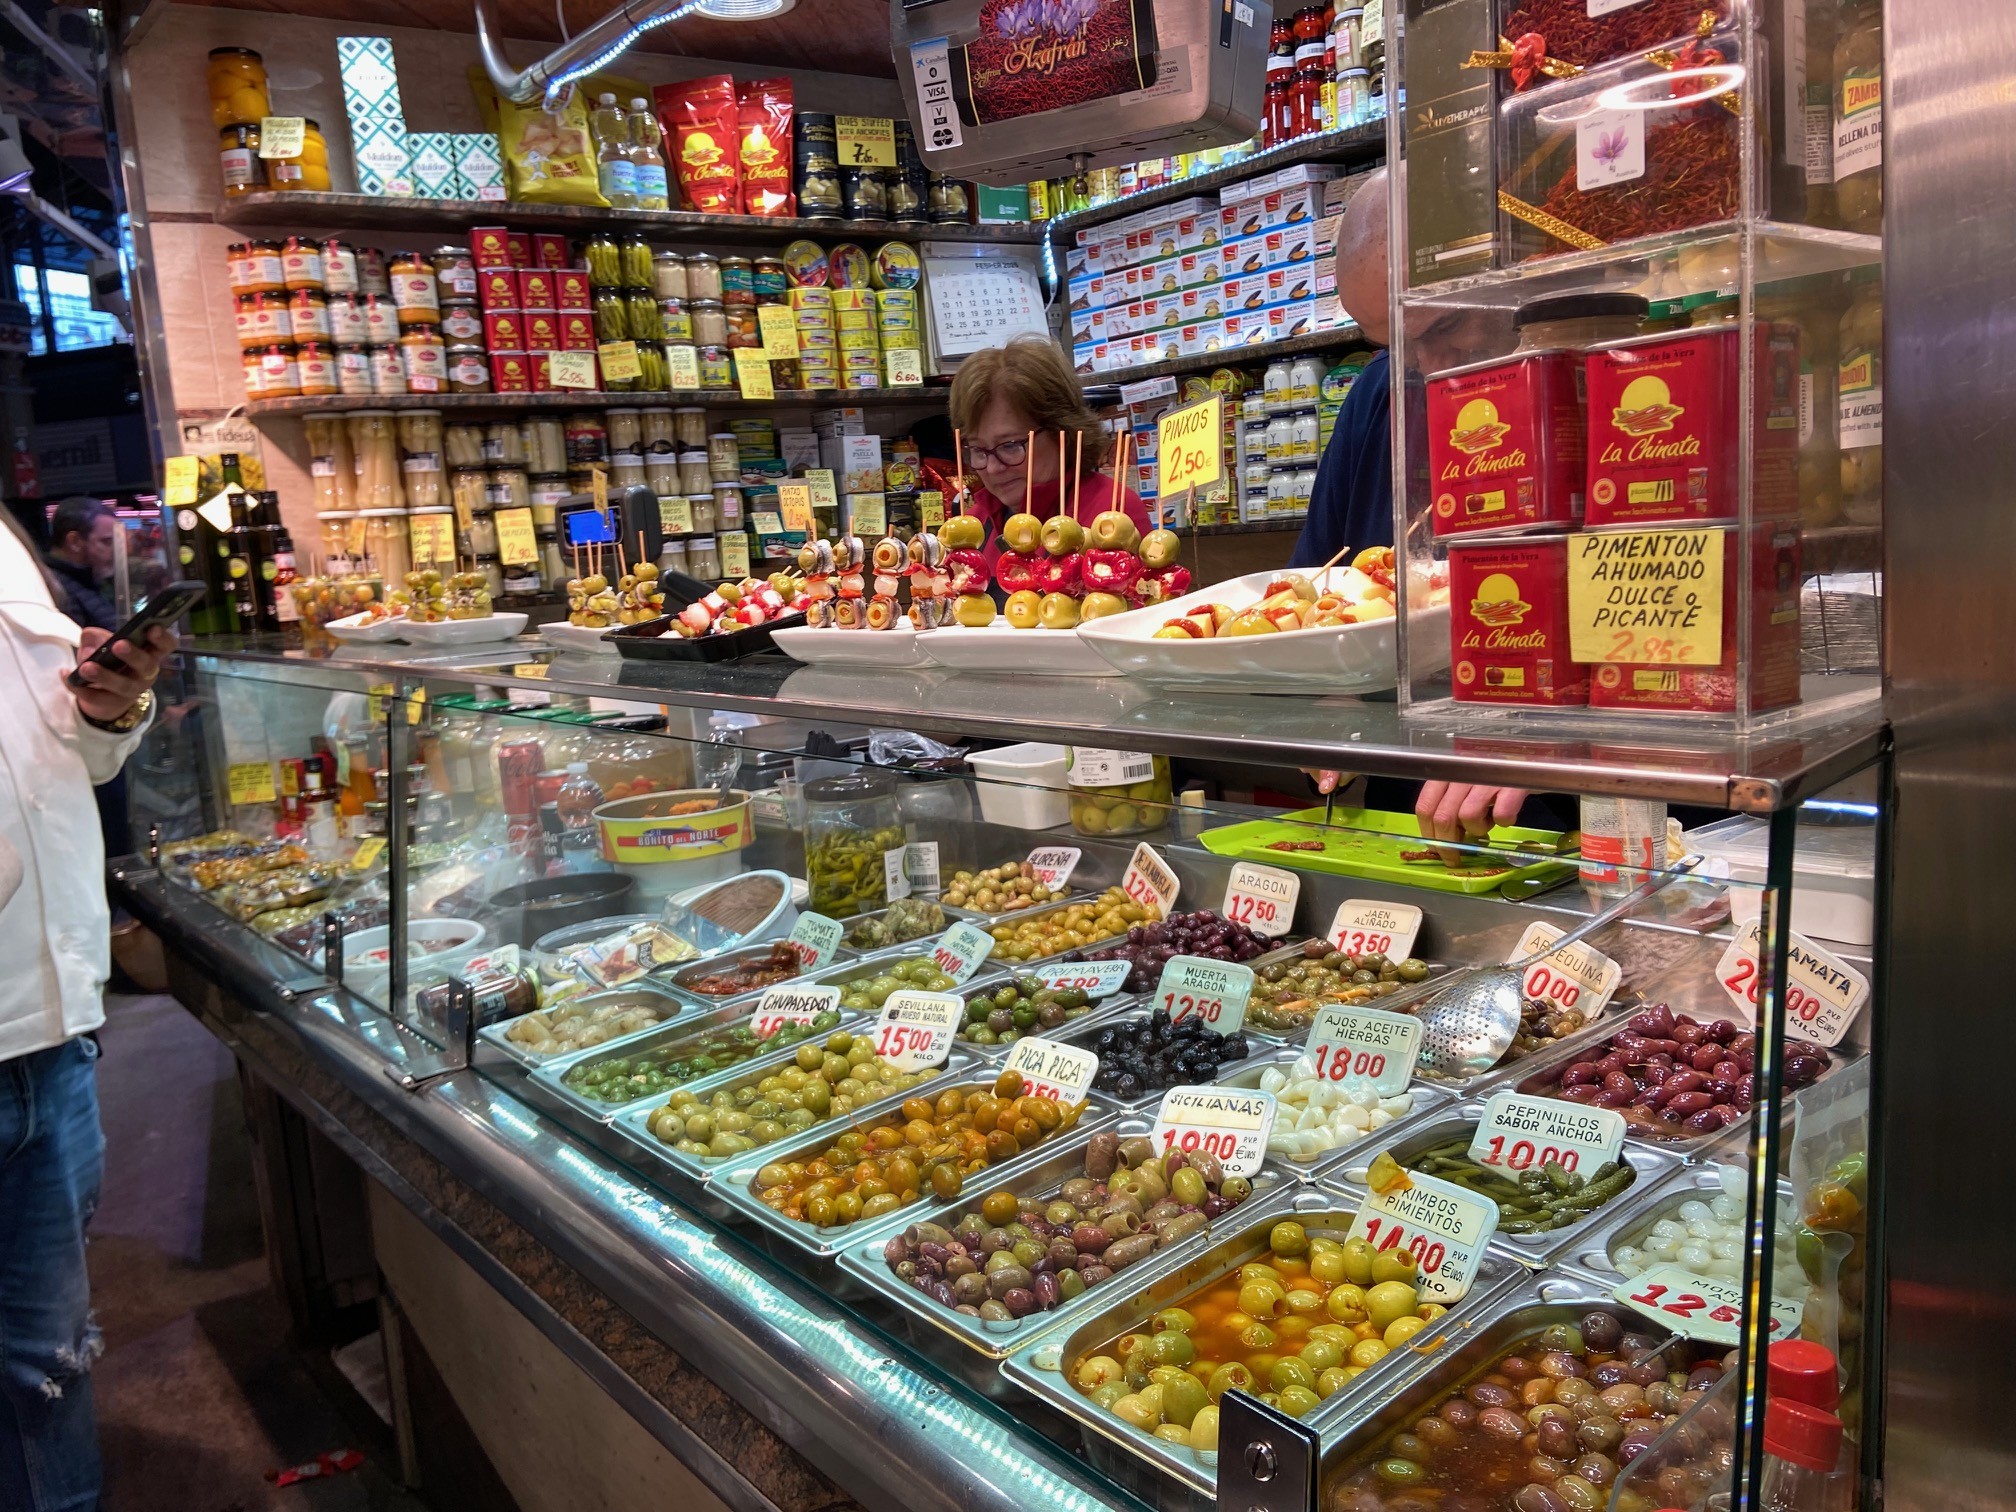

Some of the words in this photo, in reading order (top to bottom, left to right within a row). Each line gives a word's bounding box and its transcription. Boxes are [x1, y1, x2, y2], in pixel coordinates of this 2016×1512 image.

[1004, 36, 1087, 75] Azafrán
[927, 86, 947, 98] VISA
[1163, 408, 1209, 445] PINXOS
[1600, 442, 1622, 463] La
[1628, 434, 1701, 463] Chinata
[1441, 460, 1460, 482] La
[1465, 448, 1527, 478] Chinata
[1500, 554, 1510, 562] de
[1521, 552, 1539, 560] Vera
[1582, 534, 1708, 560] PIMENTON
[1591, 559, 1705, 581] AHUMADO
[1607, 585, 1679, 606] DULCE
[1592, 605, 1703, 628] PICANTE
[1461, 629, 1480, 648] La
[1485, 626, 1547, 649] Chinata
[638, 834, 674, 846] BONITO
[688, 828, 720, 842] NORTE
[1238, 873, 1288, 896] ARAGON
[1353, 915, 1397, 930] ALIÑADO
[1364, 909, 1392, 920] JAEN
[1042, 963, 1125, 977] PRIMAVERA
[1185, 966, 1228, 983] MUERTA
[1181, 977, 1227, 993] ARAGON
[763, 994, 833, 1012] CHUPADEDOS
[898, 1000, 946, 1013] SEVILLANA
[900, 1009, 921, 1020] HUESO
[922, 1012, 948, 1024] NATURAL
[1325, 1014, 1358, 1028] AJOS
[1363, 1021, 1410, 1037] ACEITE
[1335, 1028, 1391, 1045] HIERBAS
[1790, 1016, 1822, 1042] KILO.
[913, 1052, 935, 1061] KILO.
[1014, 1046, 1043, 1073] PICA
[1047, 1057, 1081, 1083] PICA
[1170, 1093, 1265, 1116] SICILIANAS
[1505, 1104, 1600, 1130] PEPINILLOS
[1495, 1114, 1540, 1132] SABOR
[1546, 1125, 1603, 1145] ANCHOA
[1402, 1186, 1458, 1216] KIMBOS
[1385, 1195, 1463, 1235] PIMIENTOS
